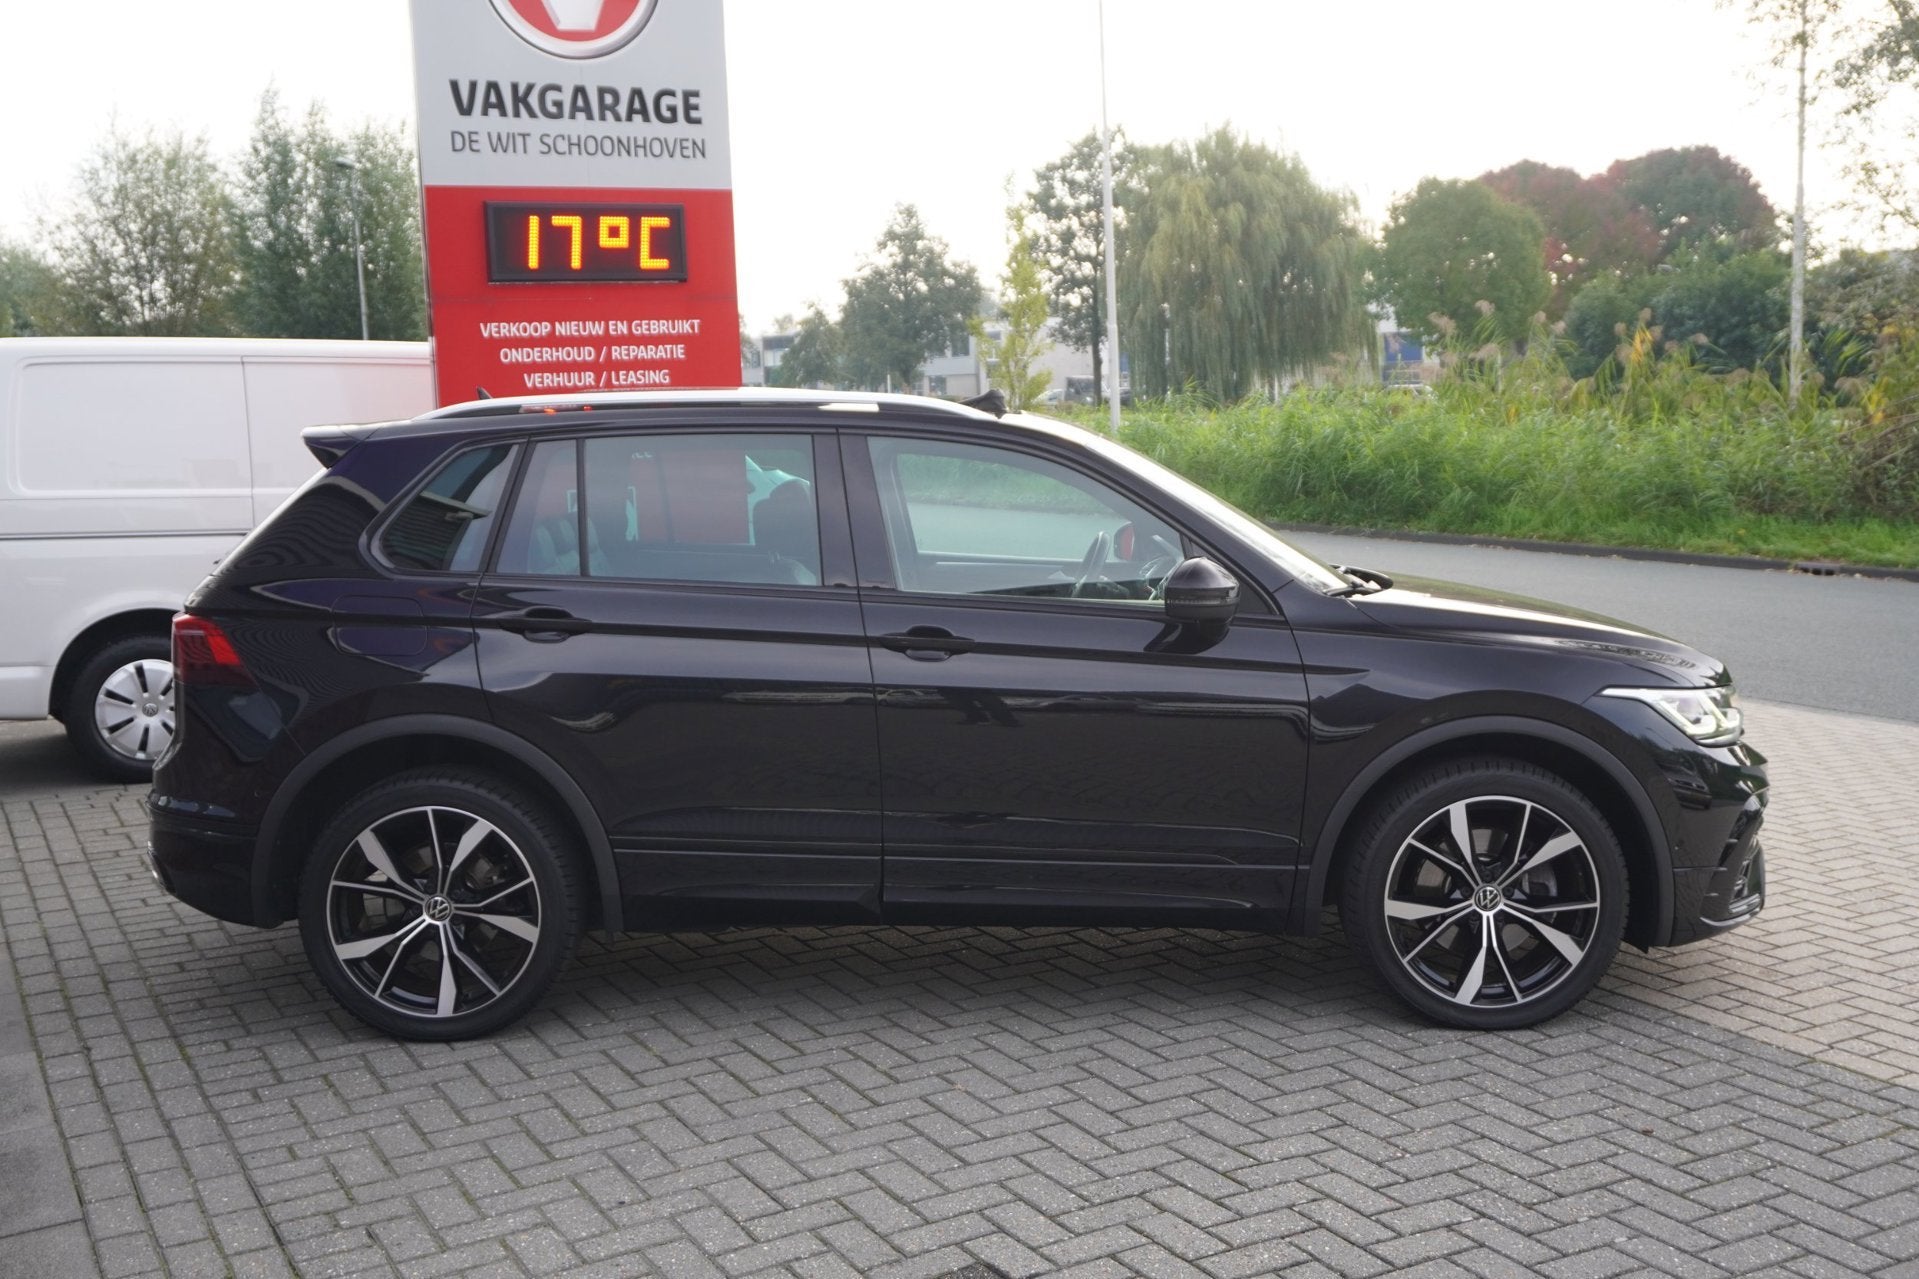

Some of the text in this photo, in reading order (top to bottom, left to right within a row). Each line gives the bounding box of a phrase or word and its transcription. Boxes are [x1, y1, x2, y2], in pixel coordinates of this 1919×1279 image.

[449, 78, 702, 124] VAKGARAGE
[450, 130, 705, 158] DE WIT SCHOONHOVEN
[480, 319, 699, 337] VERKOOP NIEUW EN GEBRUIKT
[500, 346, 594, 362] ONDERHOUD
[611, 344, 685, 360] REPARATIE
[524, 371, 594, 387] VERHUUR
[611, 369, 669, 385] LEASING
